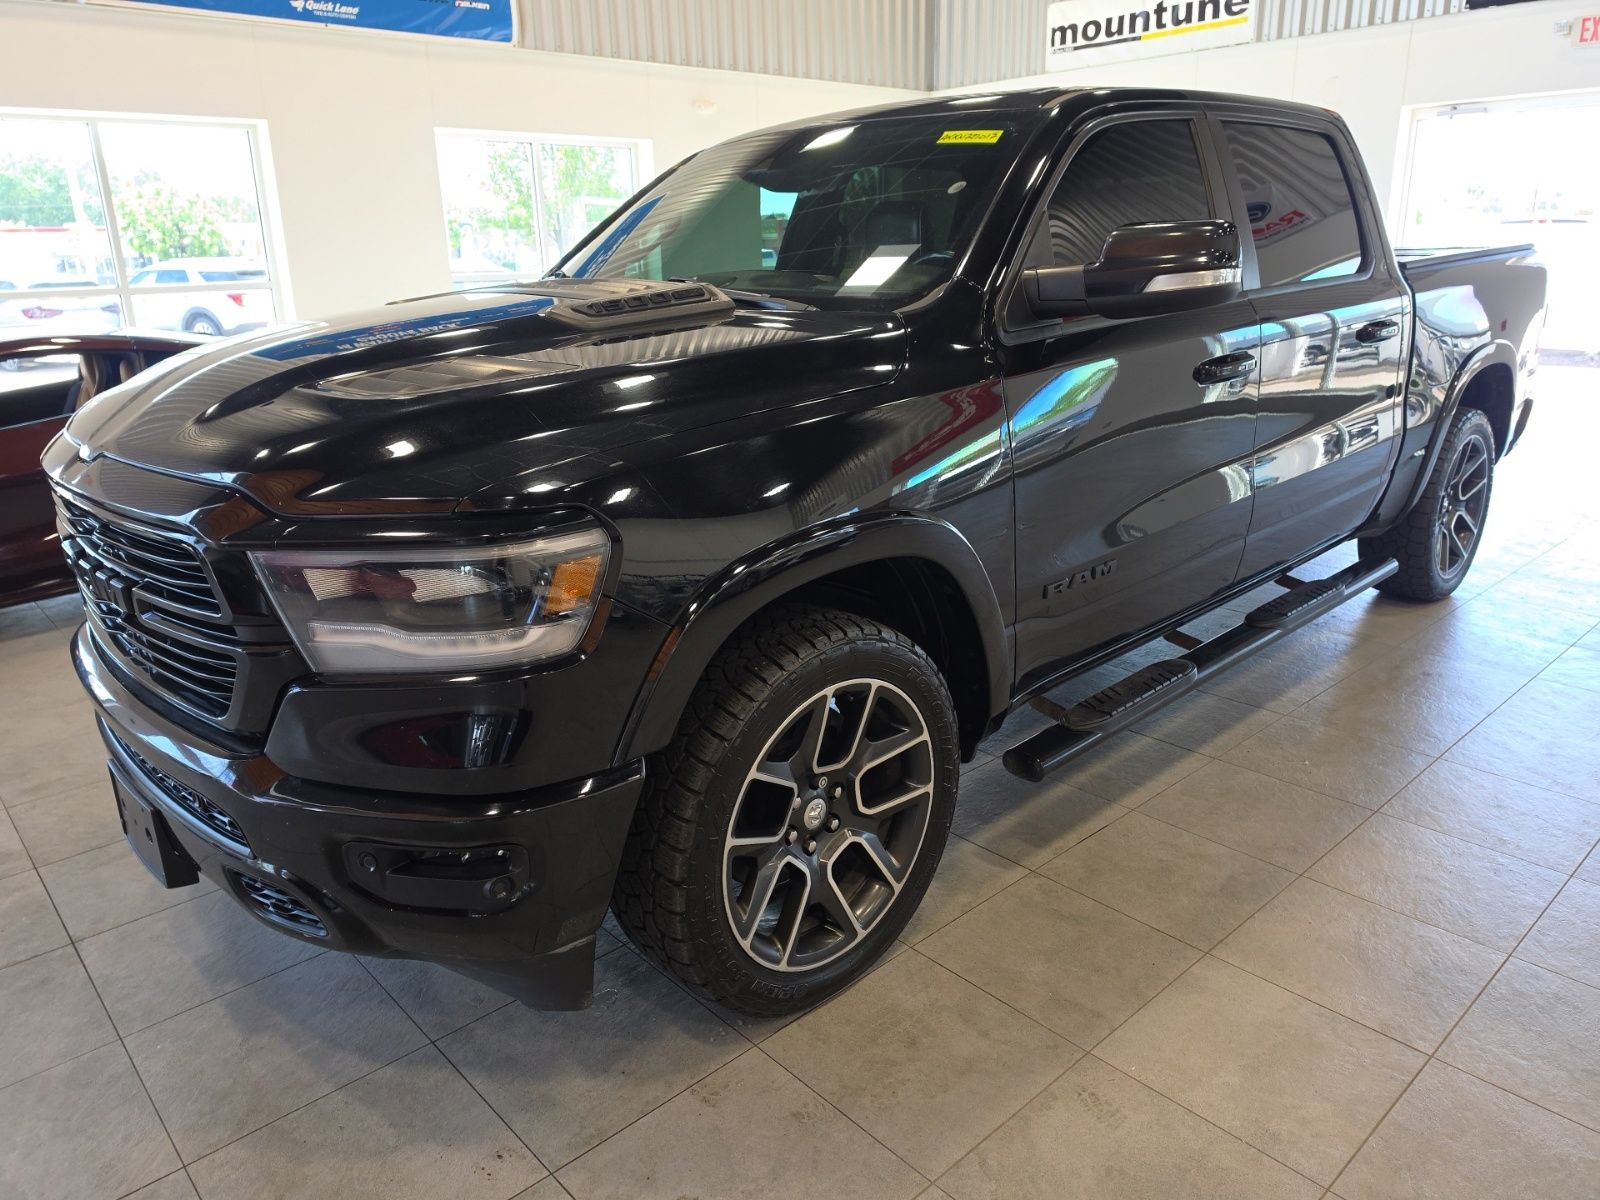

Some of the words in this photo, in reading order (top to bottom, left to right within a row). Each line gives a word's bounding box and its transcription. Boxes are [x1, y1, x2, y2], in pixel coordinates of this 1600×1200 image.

[306, 0, 334, 11] Quick
[335, 3, 360, 14] Lane
[1051, 0, 1249, 47] mountune
[1042, 558, 1118, 600] RAM
